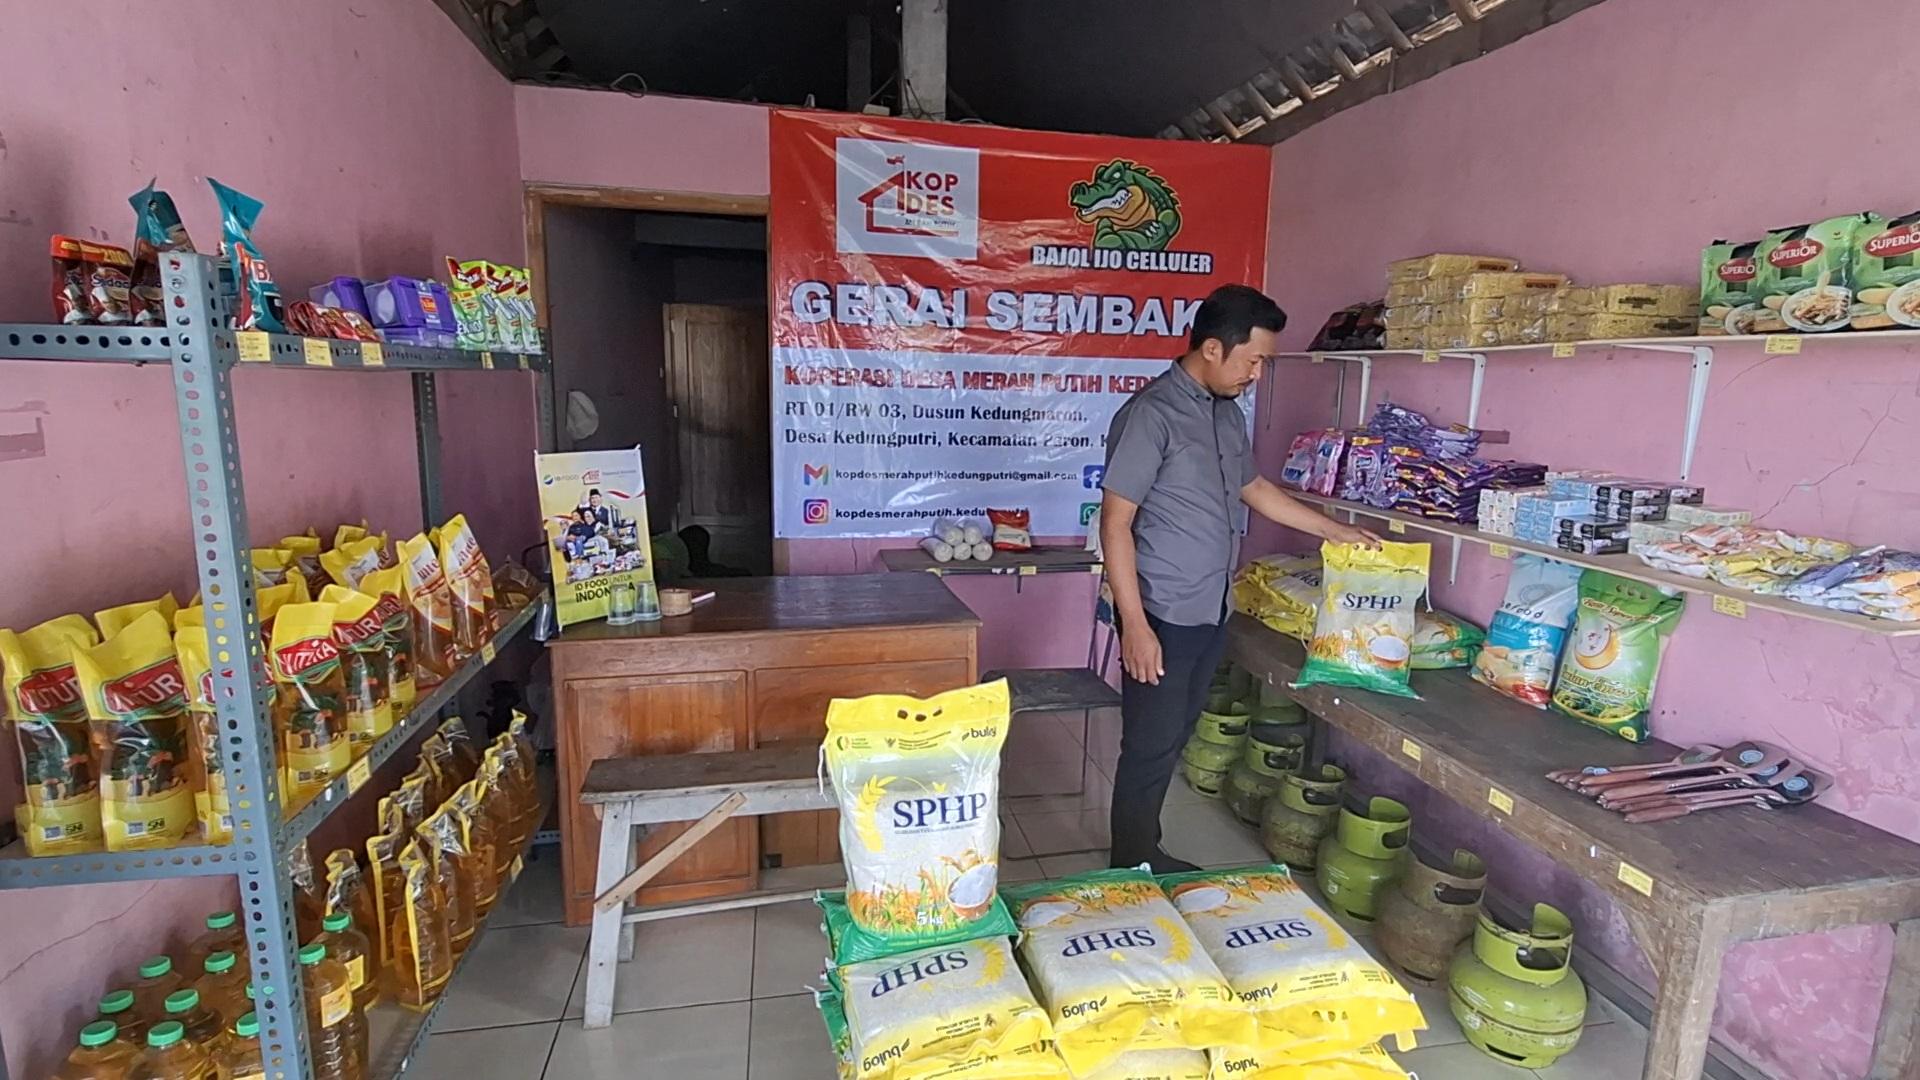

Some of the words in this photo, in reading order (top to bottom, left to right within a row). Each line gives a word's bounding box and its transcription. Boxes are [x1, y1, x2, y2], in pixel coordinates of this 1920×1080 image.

[906, 170, 959, 192] KOP
[906, 192, 955, 216] DES
[1032, 246, 1090, 268] BAJOL
[1094, 249, 1124, 269] IJO
[1126, 251, 1212, 273] CELLULER
[1771, 245, 1818, 263] SUPERIOR
[790, 280, 967, 328] GERAI
[784, 365, 894, 388] KOPERASI
[900, 370, 957, 389] DESA
[962, 370, 1035, 391] MERAH
[1041, 373, 1103, 394] PUTIH
[1108, 375, 1156, 395] KED
[785, 401, 808, 416] RT
[814, 401, 873, 420] 01/RW
[878, 403, 907, 420] 03,
[913, 404, 965, 420] Dusun
[785, 428, 827, 444] Desa
[833, 429, 942, 449] Kedungputri,
[947, 431, 1037, 448] Kecamatan
[835, 507, 1029, 520] kopdesmerahputih.kedu
[575, 581, 636, 603] INDONA
[584, 578, 608, 590] FOOD
[1342, 592, 1403, 610] SPHP
[892, 791, 988, 829] SPHP
[916, 911, 927, 925] 5
[1061, 928, 1156, 958] SPHP
[1225, 919, 1313, 949] SPHP
[870, 950, 969, 999] SPHP
[1061, 999, 1099, 1019] bulog
[863, 1044, 902, 1072] bulog
